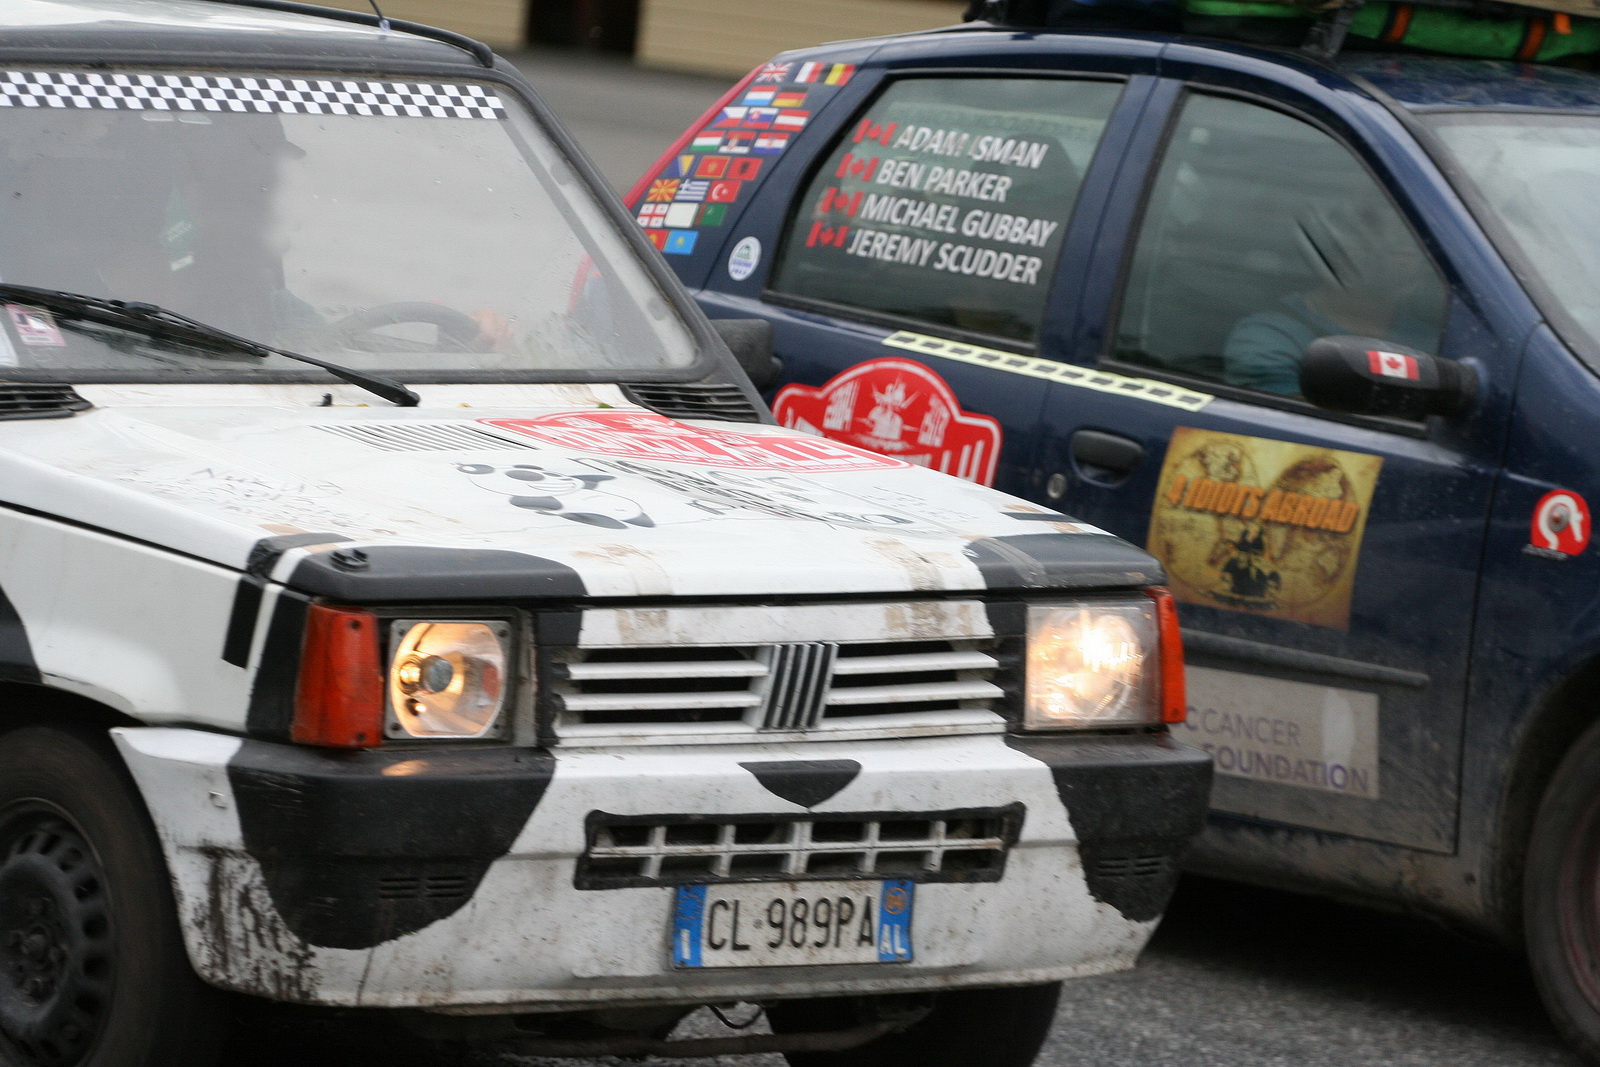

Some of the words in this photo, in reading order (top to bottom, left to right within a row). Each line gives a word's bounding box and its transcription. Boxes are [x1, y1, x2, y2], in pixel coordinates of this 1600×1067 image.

[894, 125, 969, 158] ADAM
[876, 159, 926, 190] BEN
[924, 164, 1013, 202] PARKER
[860, 194, 961, 234] MICHAEL
[962, 209, 1058, 247] GUBBAY
[846, 229, 938, 267] JEREMY
[934, 243, 1042, 285] SCUDDER
[1259, 488, 1360, 533] ABROAD
[1202, 708, 1301, 747] CANCER
[708, 899, 750, 951] CL
[766, 895, 875, 949] 989PA
[879, 924, 907, 955] AL
